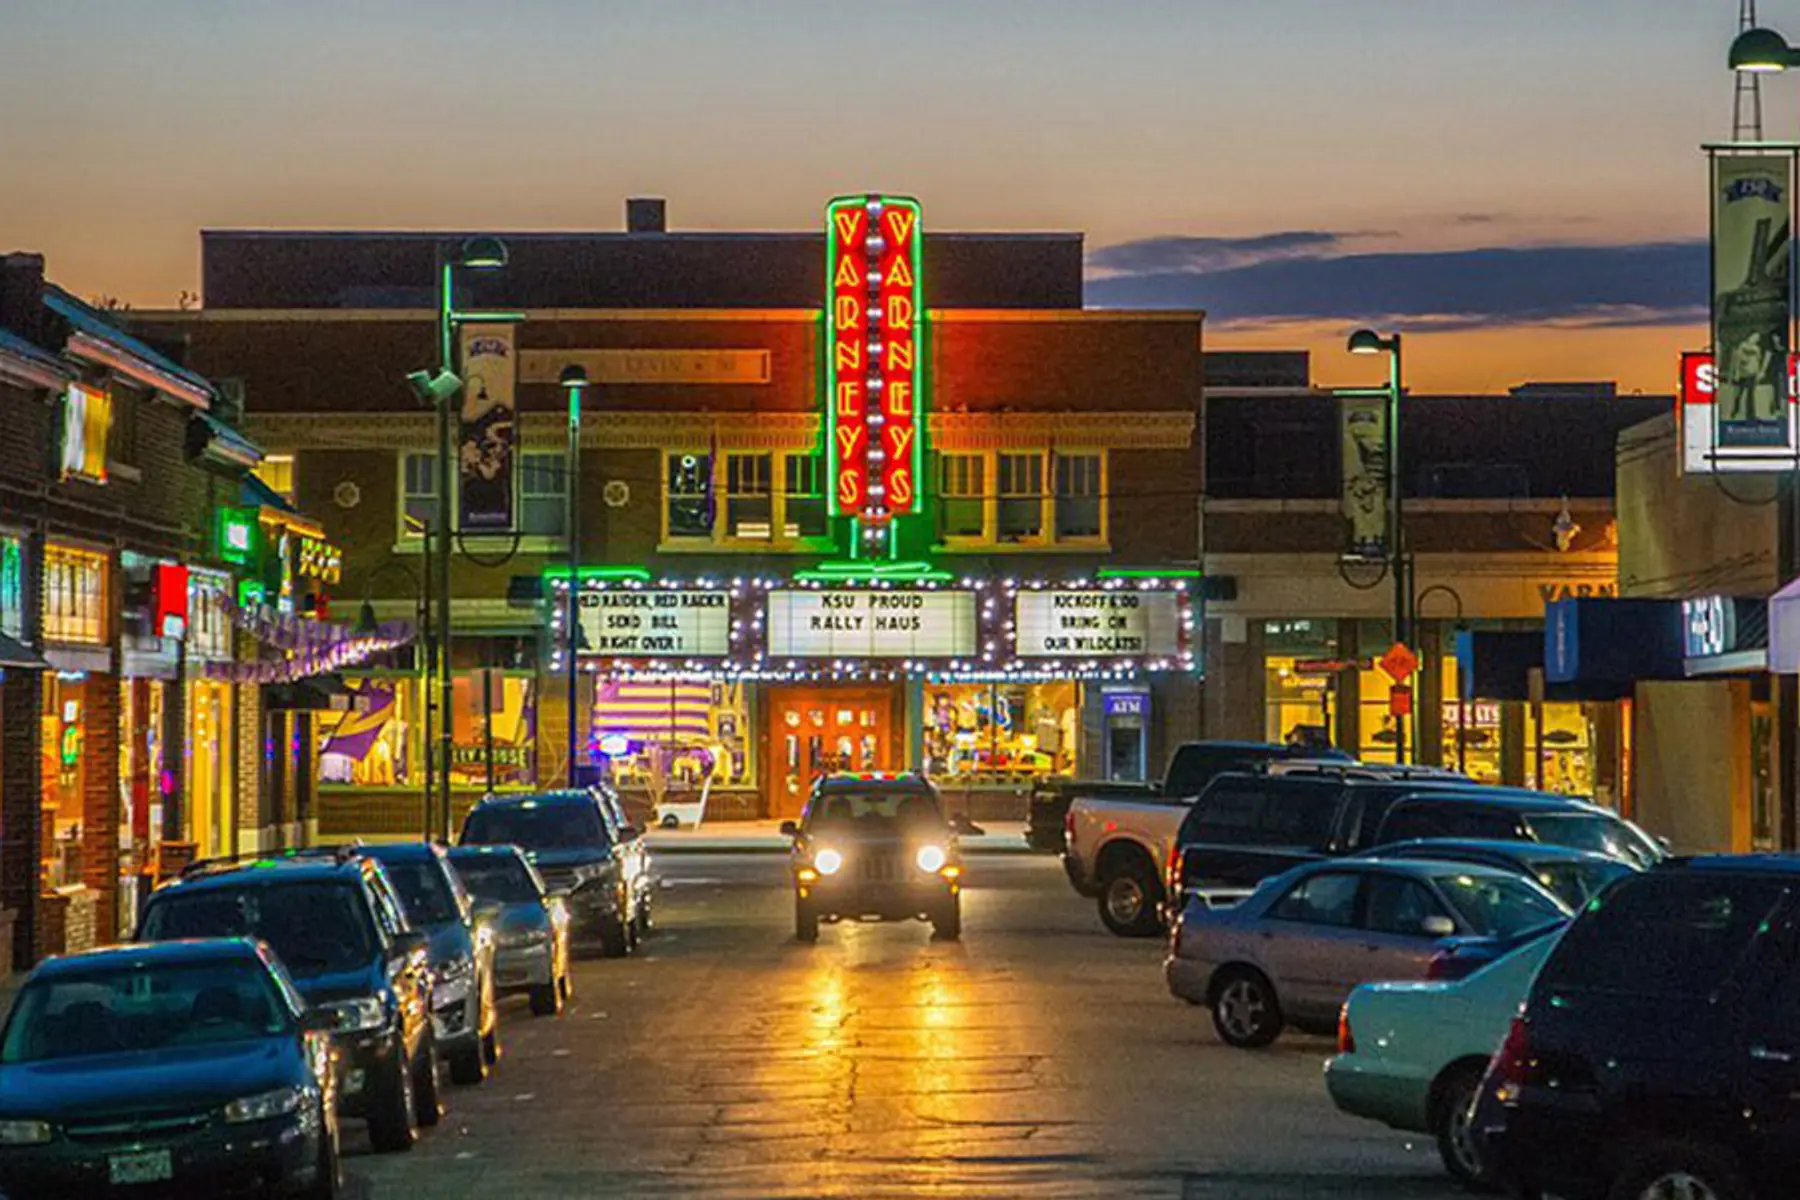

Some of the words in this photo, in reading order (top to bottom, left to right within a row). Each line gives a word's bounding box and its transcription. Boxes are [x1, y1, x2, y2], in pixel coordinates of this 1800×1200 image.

[654, 594, 677, 607] RED
[681, 594, 725, 607] RAIDER
[821, 595, 855, 608] KSU
[868, 595, 923, 608] PROUD
[1054, 595, 1106, 608] KICKOFF
[607, 615, 641, 628] SEND
[652, 615, 677, 628] BILL
[811, 616, 864, 629] RALLY
[876, 616, 921, 629] HAUS
[1061, 616, 1099, 628] BRING
[1108, 616, 1127, 628] ON
[600, 636, 638, 650] RIGHT
[1044, 636, 1069, 650] OUR
[1112, 700, 1140, 713] ATM
